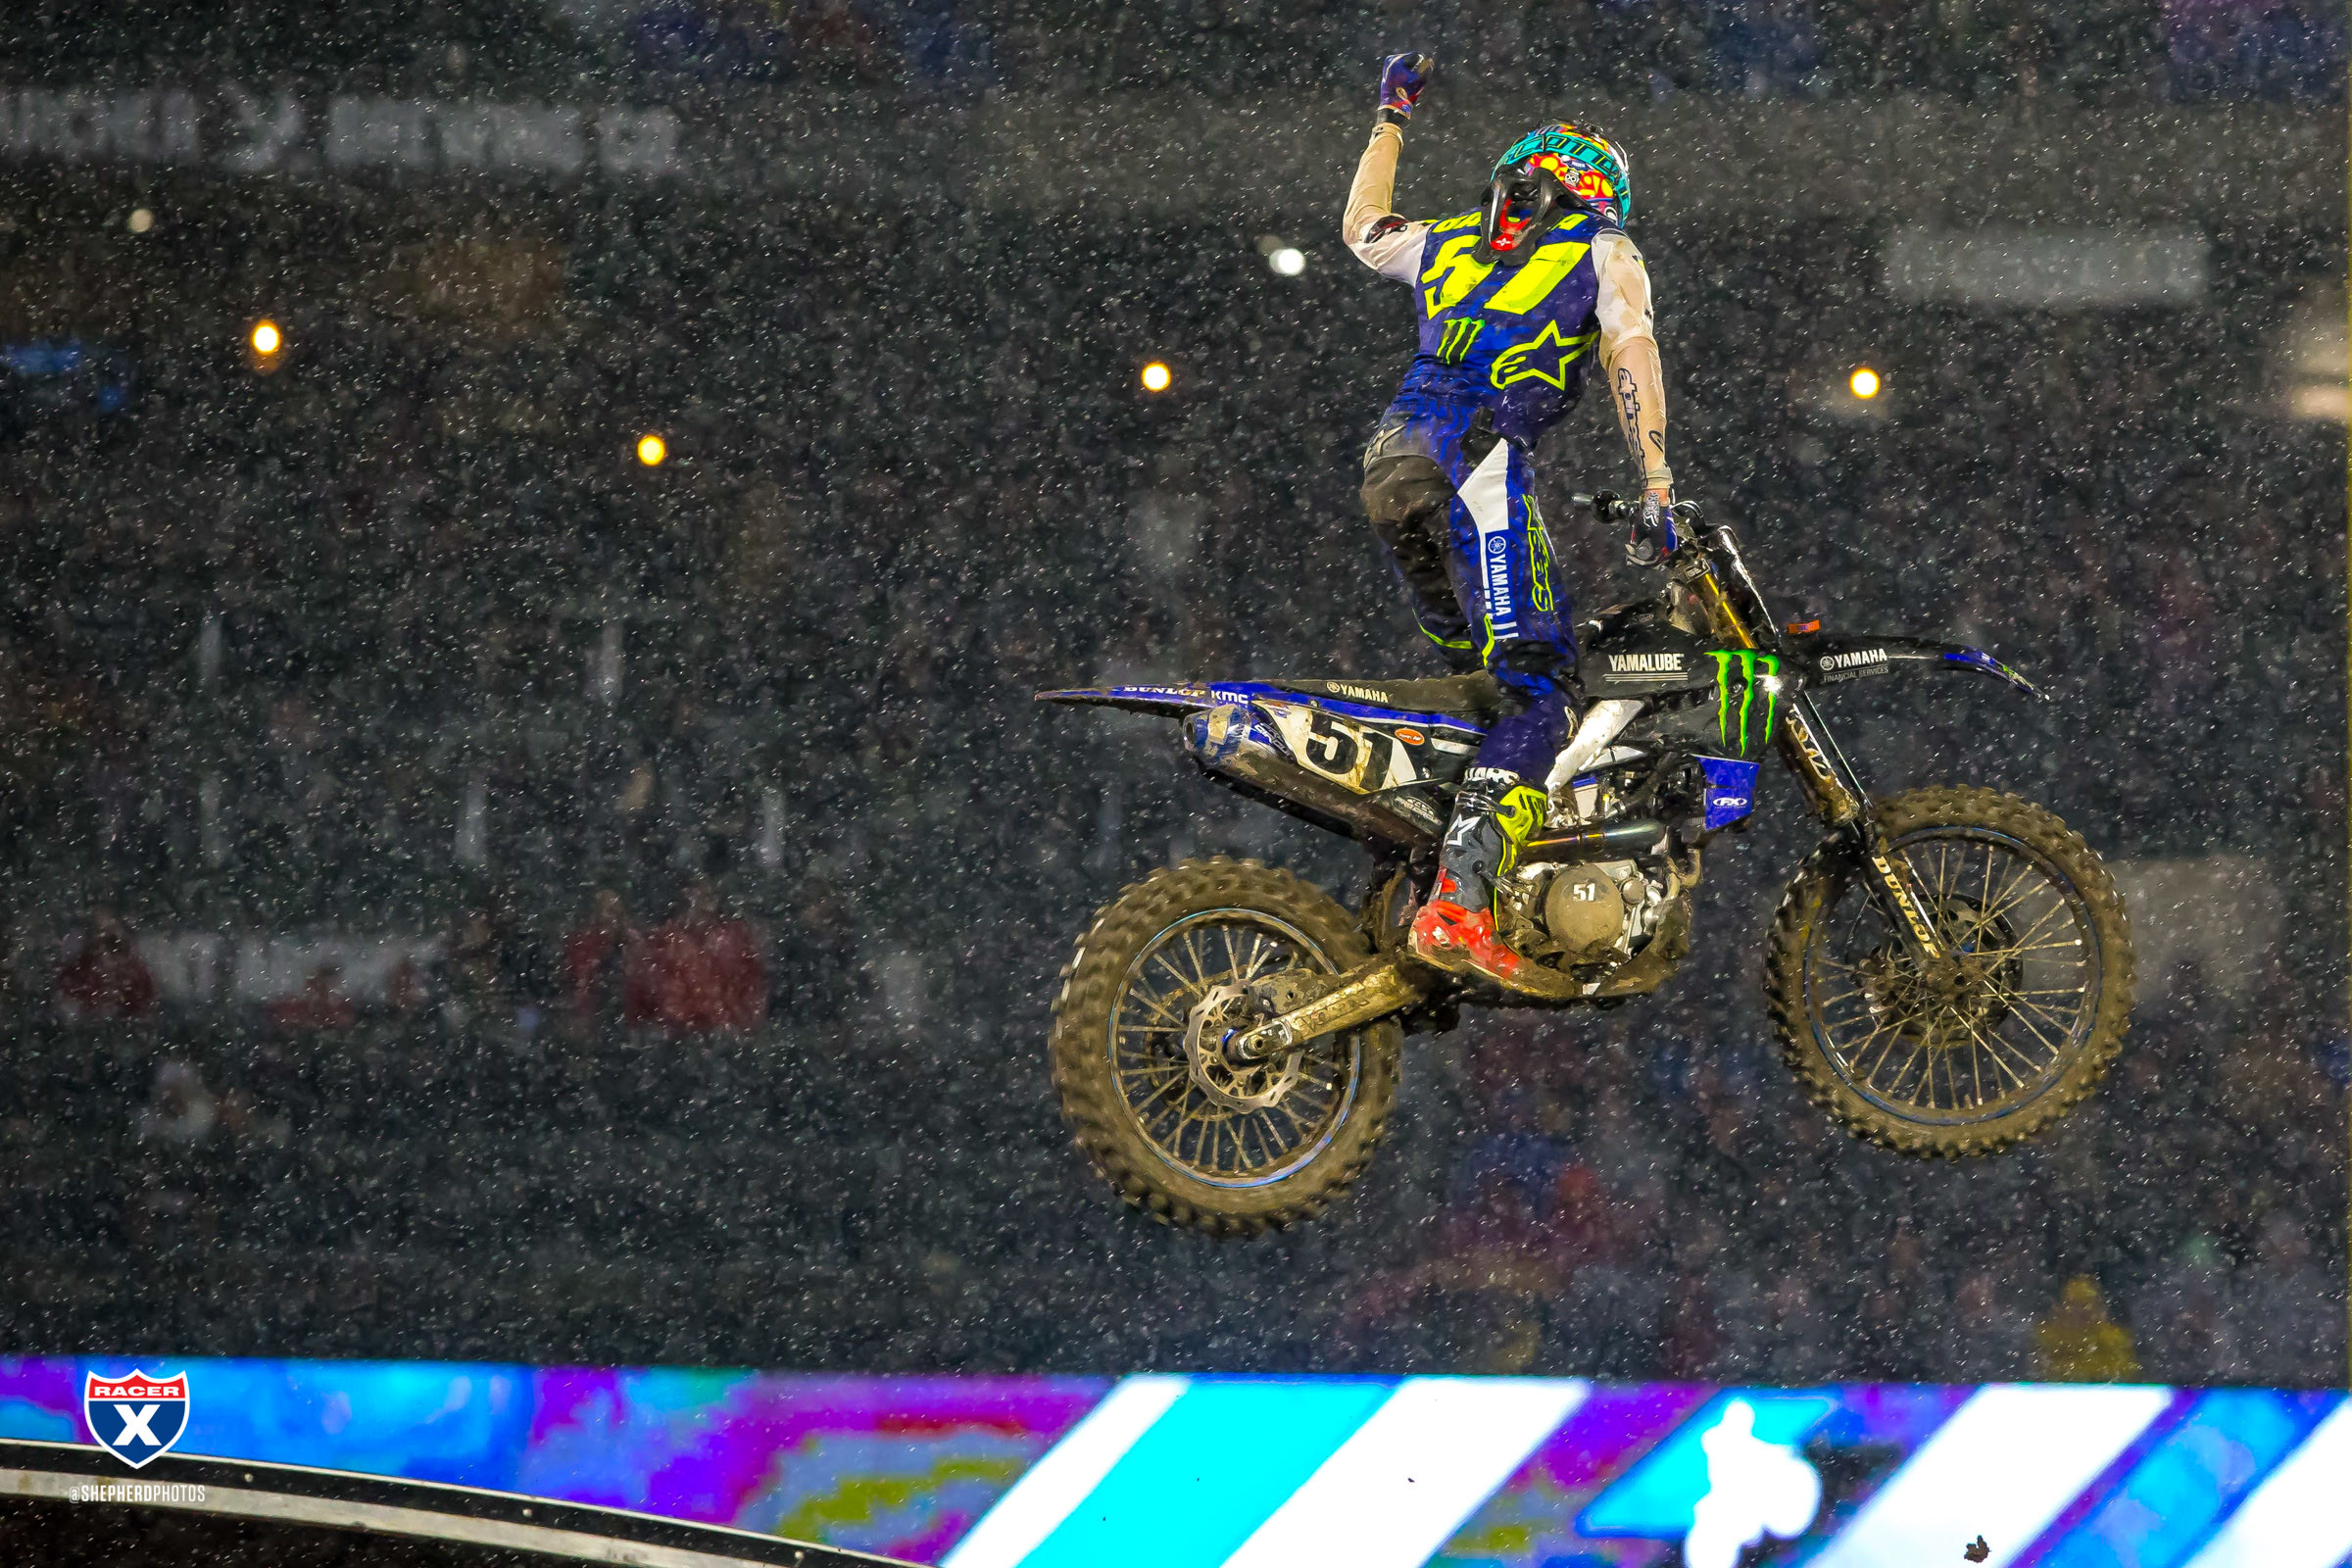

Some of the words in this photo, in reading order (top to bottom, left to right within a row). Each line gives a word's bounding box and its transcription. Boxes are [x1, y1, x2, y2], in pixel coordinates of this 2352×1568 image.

[1421, 234, 1591, 319] 51
[1490, 554, 1511, 616] YAMAHA
[1608, 653, 1683, 672] YAMALUBE
[1834, 648, 1887, 668] YAMAHA
[1824, 671, 1857, 683] FINANCIAL
[1858, 665, 1889, 678] SERVICES
[1340, 684, 1389, 704] YAMAHA
[1305, 710, 1394, 792] 51
[1573, 882, 1595, 902] 51
[1872, 856, 1940, 958] DUNLOP
